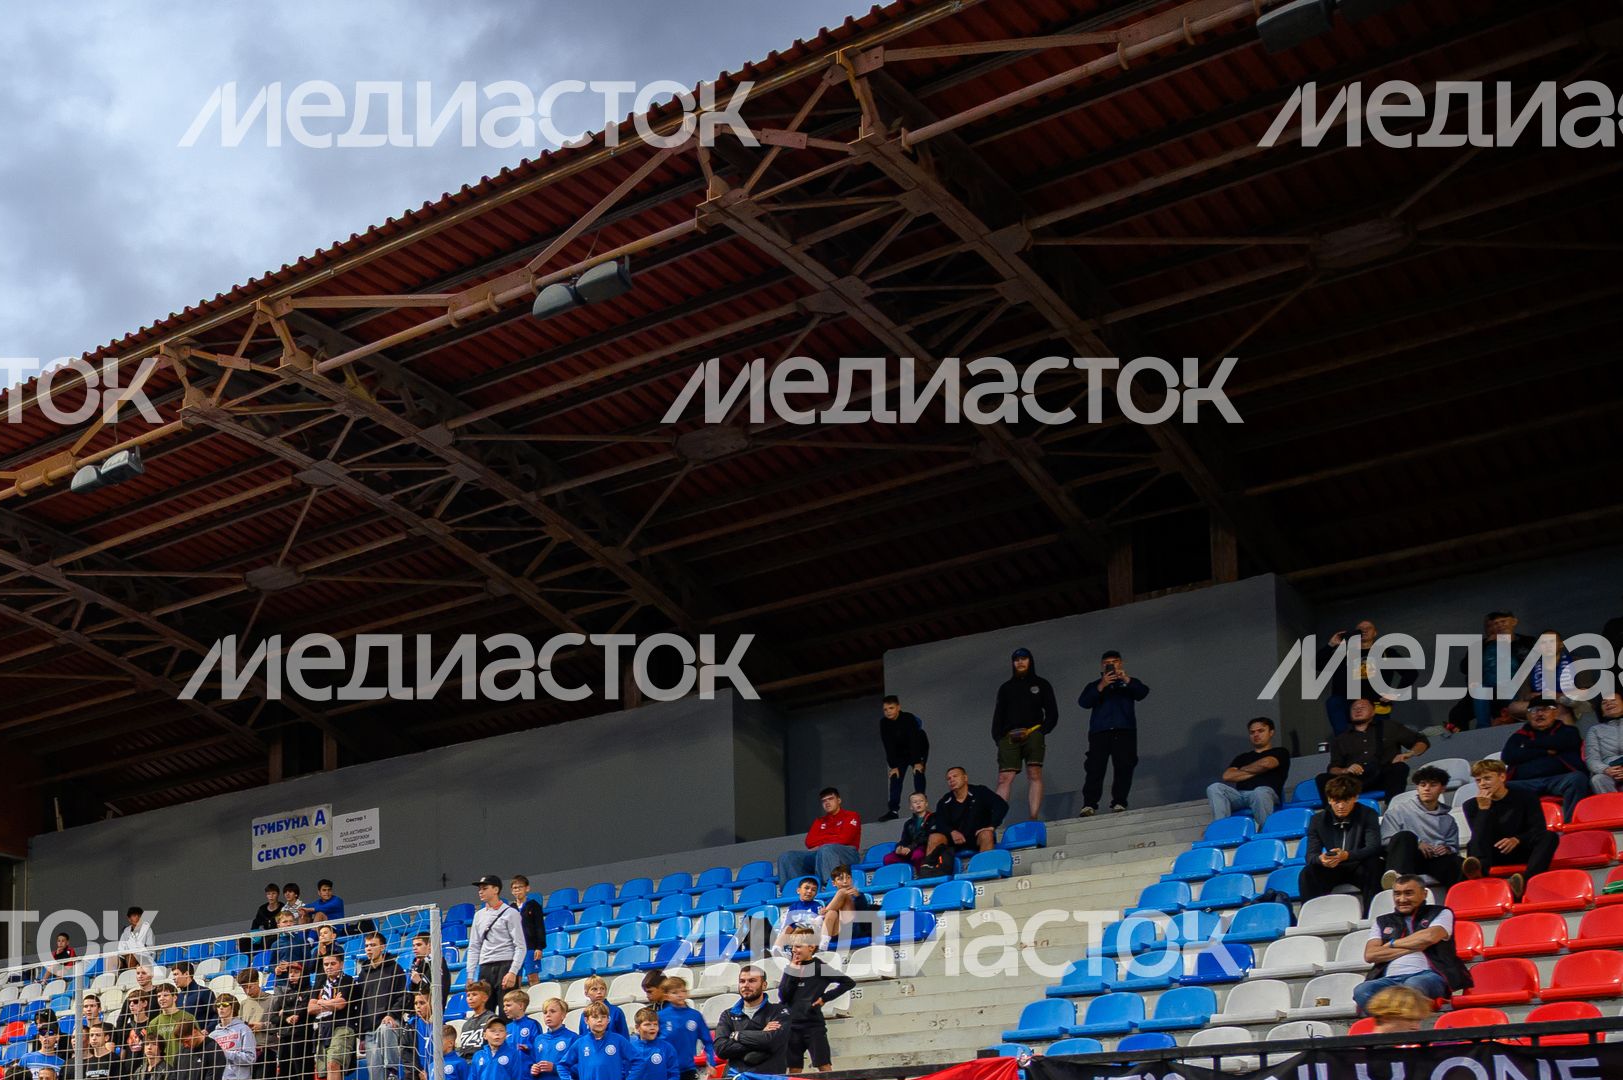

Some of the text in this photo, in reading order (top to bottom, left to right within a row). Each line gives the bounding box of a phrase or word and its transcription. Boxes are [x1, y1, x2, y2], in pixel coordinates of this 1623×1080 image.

[253, 809, 326, 836] ТРИБУНА А
[257, 837, 323, 862] СЕКТОР 1
